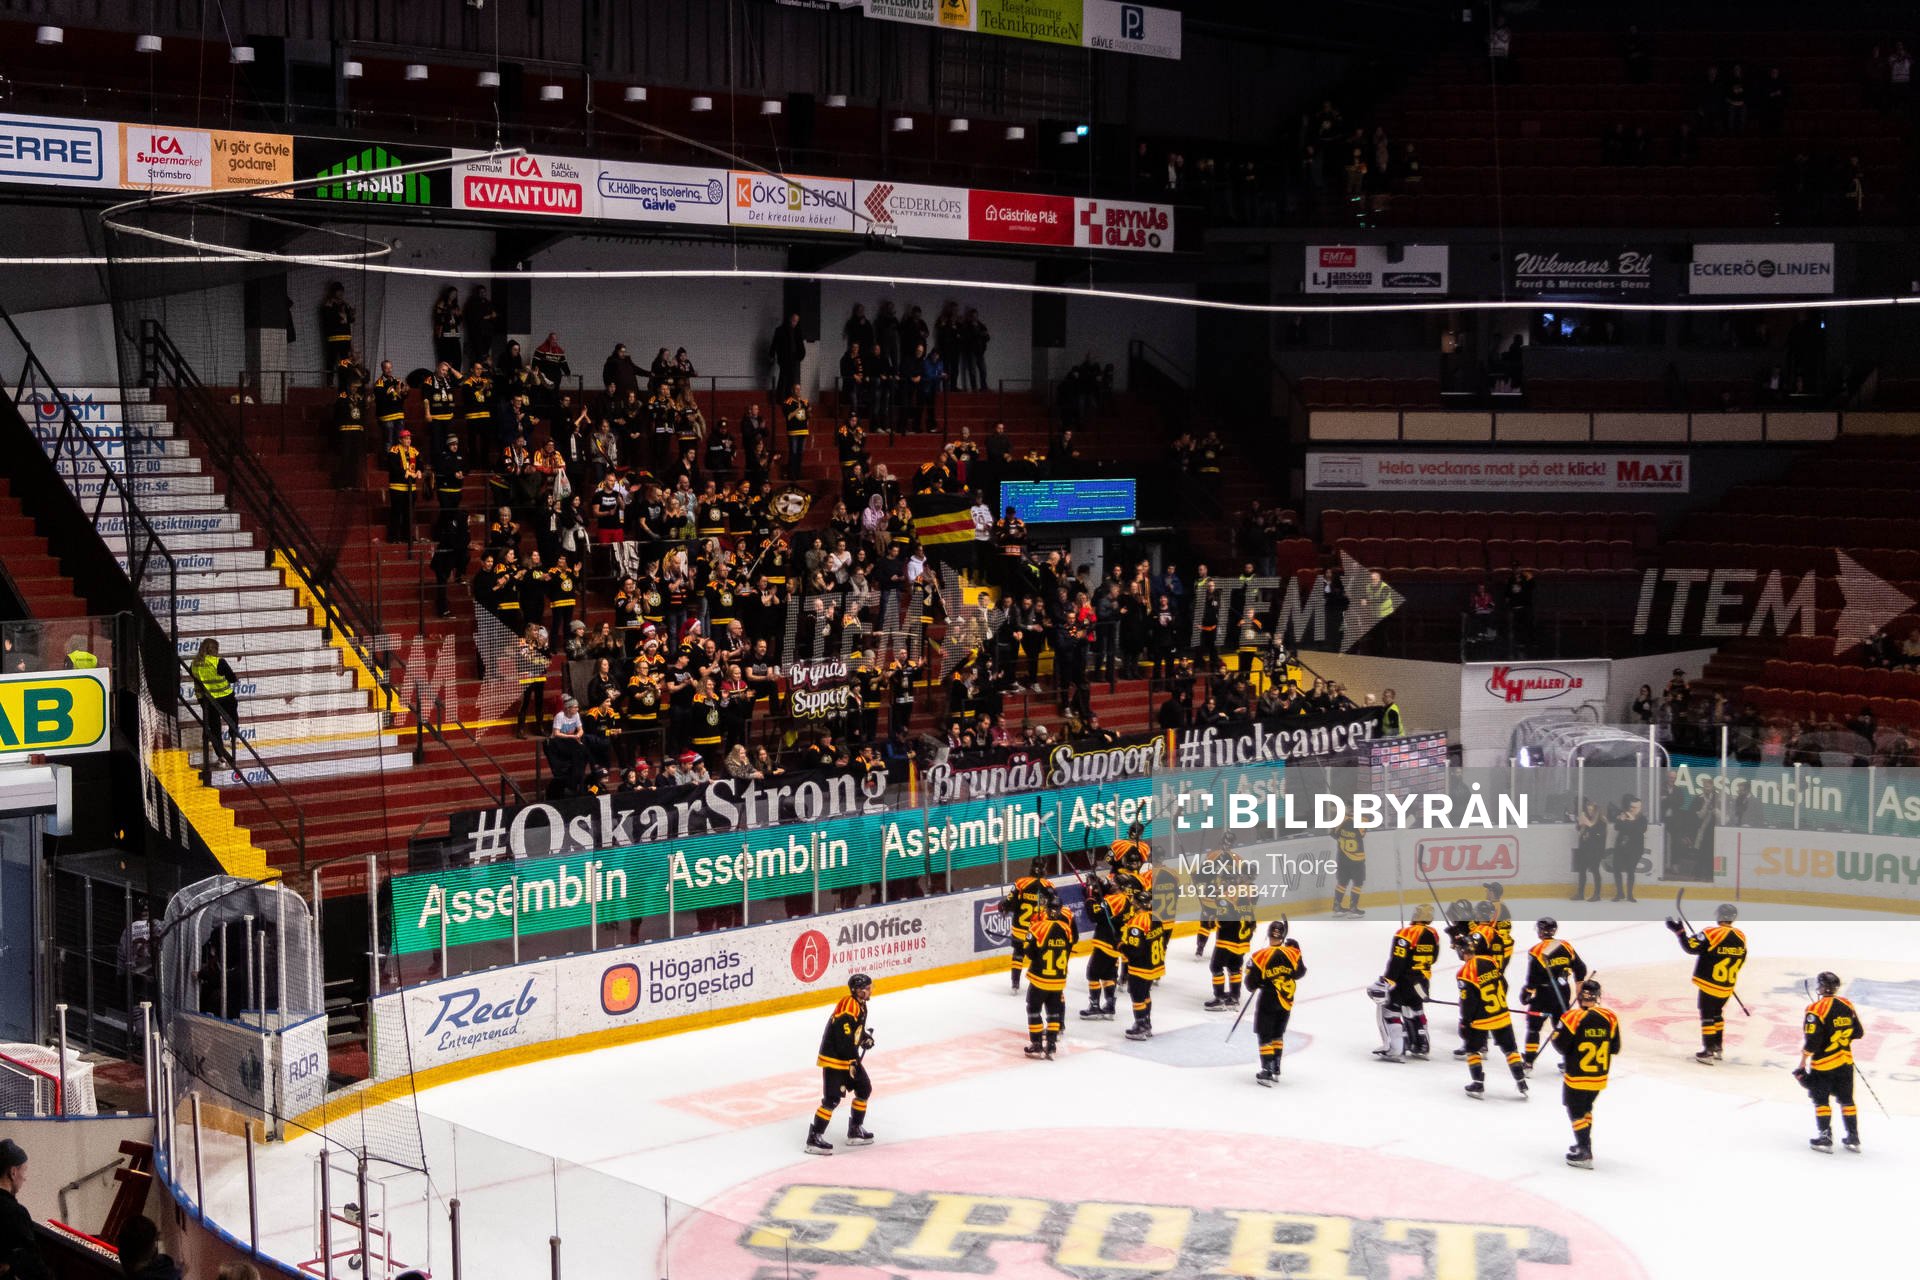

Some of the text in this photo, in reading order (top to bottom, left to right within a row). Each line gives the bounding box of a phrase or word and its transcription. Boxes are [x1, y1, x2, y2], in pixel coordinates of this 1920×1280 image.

[1001, 0, 1062, 22] Restaurang
[1091, 35, 1113, 49] GÄVLE
[150, 135, 183, 154] ICA
[214, 139, 289, 156] Vi gör Gävle
[136, 152, 202, 167] Supermarket
[229, 157, 277, 171] godare!
[466, 164, 502, 173] CENTRUM
[510, 156, 543, 178] ICA
[147, 169, 191, 180] Strömsbro
[551, 170, 579, 179] BACKEN
[469, 182, 577, 208] KVANTUM
[642, 198, 677, 211] Gävle
[738, 181, 848, 208] KÖKSDESIGN
[889, 197, 961, 214] CEDERLÖFS
[749, 210, 836, 225] Det kreativa köket!
[998, 207, 1058, 224] Gästrike Plåt
[1105, 207, 1168, 231] BRYNÄS
[1105, 228, 1146, 248] GLAS
[1514, 251, 1652, 274] Wikmans Bil
[1693, 260, 1831, 276] ECKERÖ LINJEN
[1515, 280, 1651, 289] Ford & Mercedes-Benz
[110, 460, 125, 473] 51
[1378, 460, 1607, 478] Hela veckans mat på ett klick!
[1190, 575, 1328, 648] ITEM
[1632, 567, 1817, 638] ITEM
[789, 659, 848, 687] Brynäs
[1525, 677, 1566, 690] MÅLERI
[1568, 678, 1583, 689] AB
[927, 753, 1043, 801] Brynäs
[1051, 737, 1164, 787] Support
[1179, 718, 1379, 770] #fuckcancer
[1674, 763, 1842, 812] Assemblin
[467, 769, 891, 864] #OskarStrong
[1068, 780, 1211, 832] Assemblin
[883, 802, 1041, 859] Assemblin
[668, 830, 849, 891] Assemblin
[1420, 843, 1515, 873] JULA
[1754, 846, 1920, 886] SUBWAY
[418, 861, 628, 929] Assemblin
[837, 917, 923, 946] AllOffice
[832, 937, 927, 965] KONTORSVARUHUS
[1042, 949, 1068, 976] 14
[649, 950, 740, 982] Höganäs
[847, 955, 913, 975] www.alloffice.se
[649, 966, 754, 1004] Borgestad
[424, 978, 538, 1037] Reab
[437, 1017, 520, 1052] Entreprenad
[1578, 1041, 1609, 1072] 24
[746, 1183, 1567, 1280] SPORT
